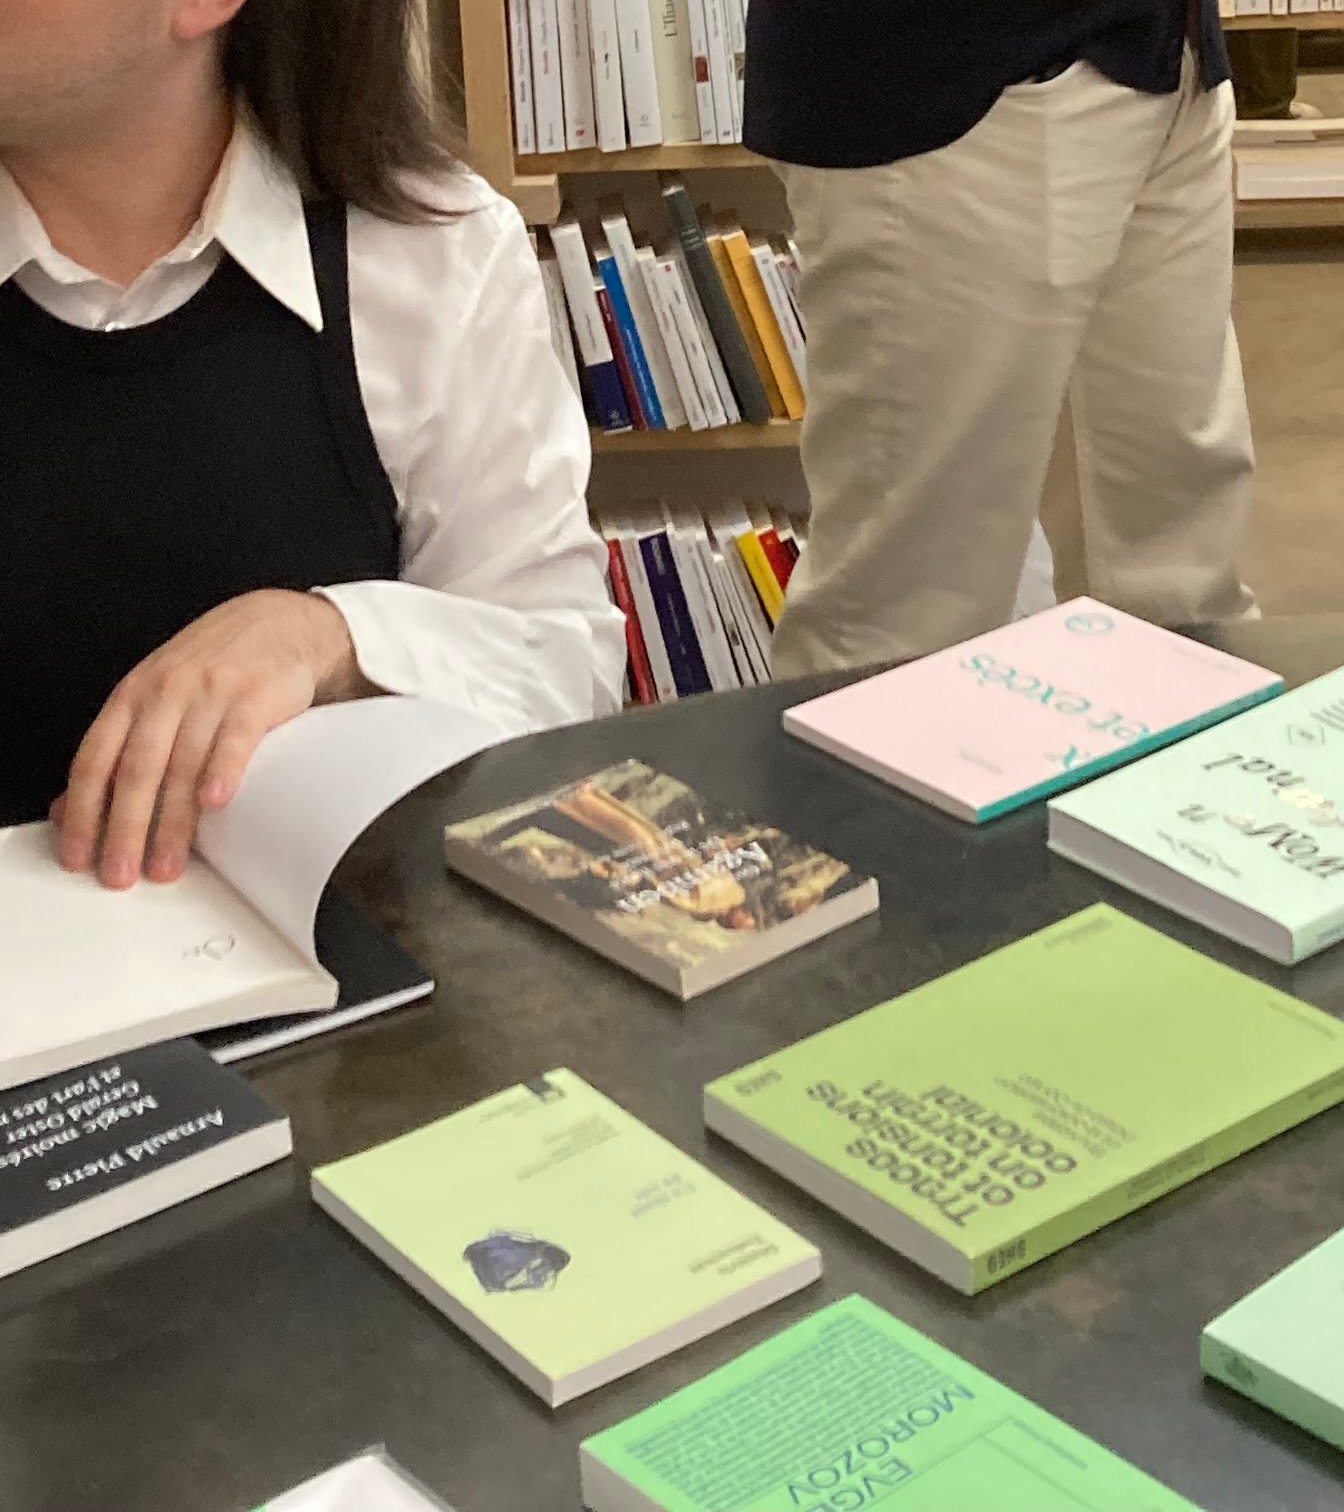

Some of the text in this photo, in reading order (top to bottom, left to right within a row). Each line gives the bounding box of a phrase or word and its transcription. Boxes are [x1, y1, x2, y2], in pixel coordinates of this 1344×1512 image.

[46, 1146, 124, 1192] Pierre
[786, 1384, 975, 1505] MOROZOV
[806, 1458, 912, 1512] EVG
